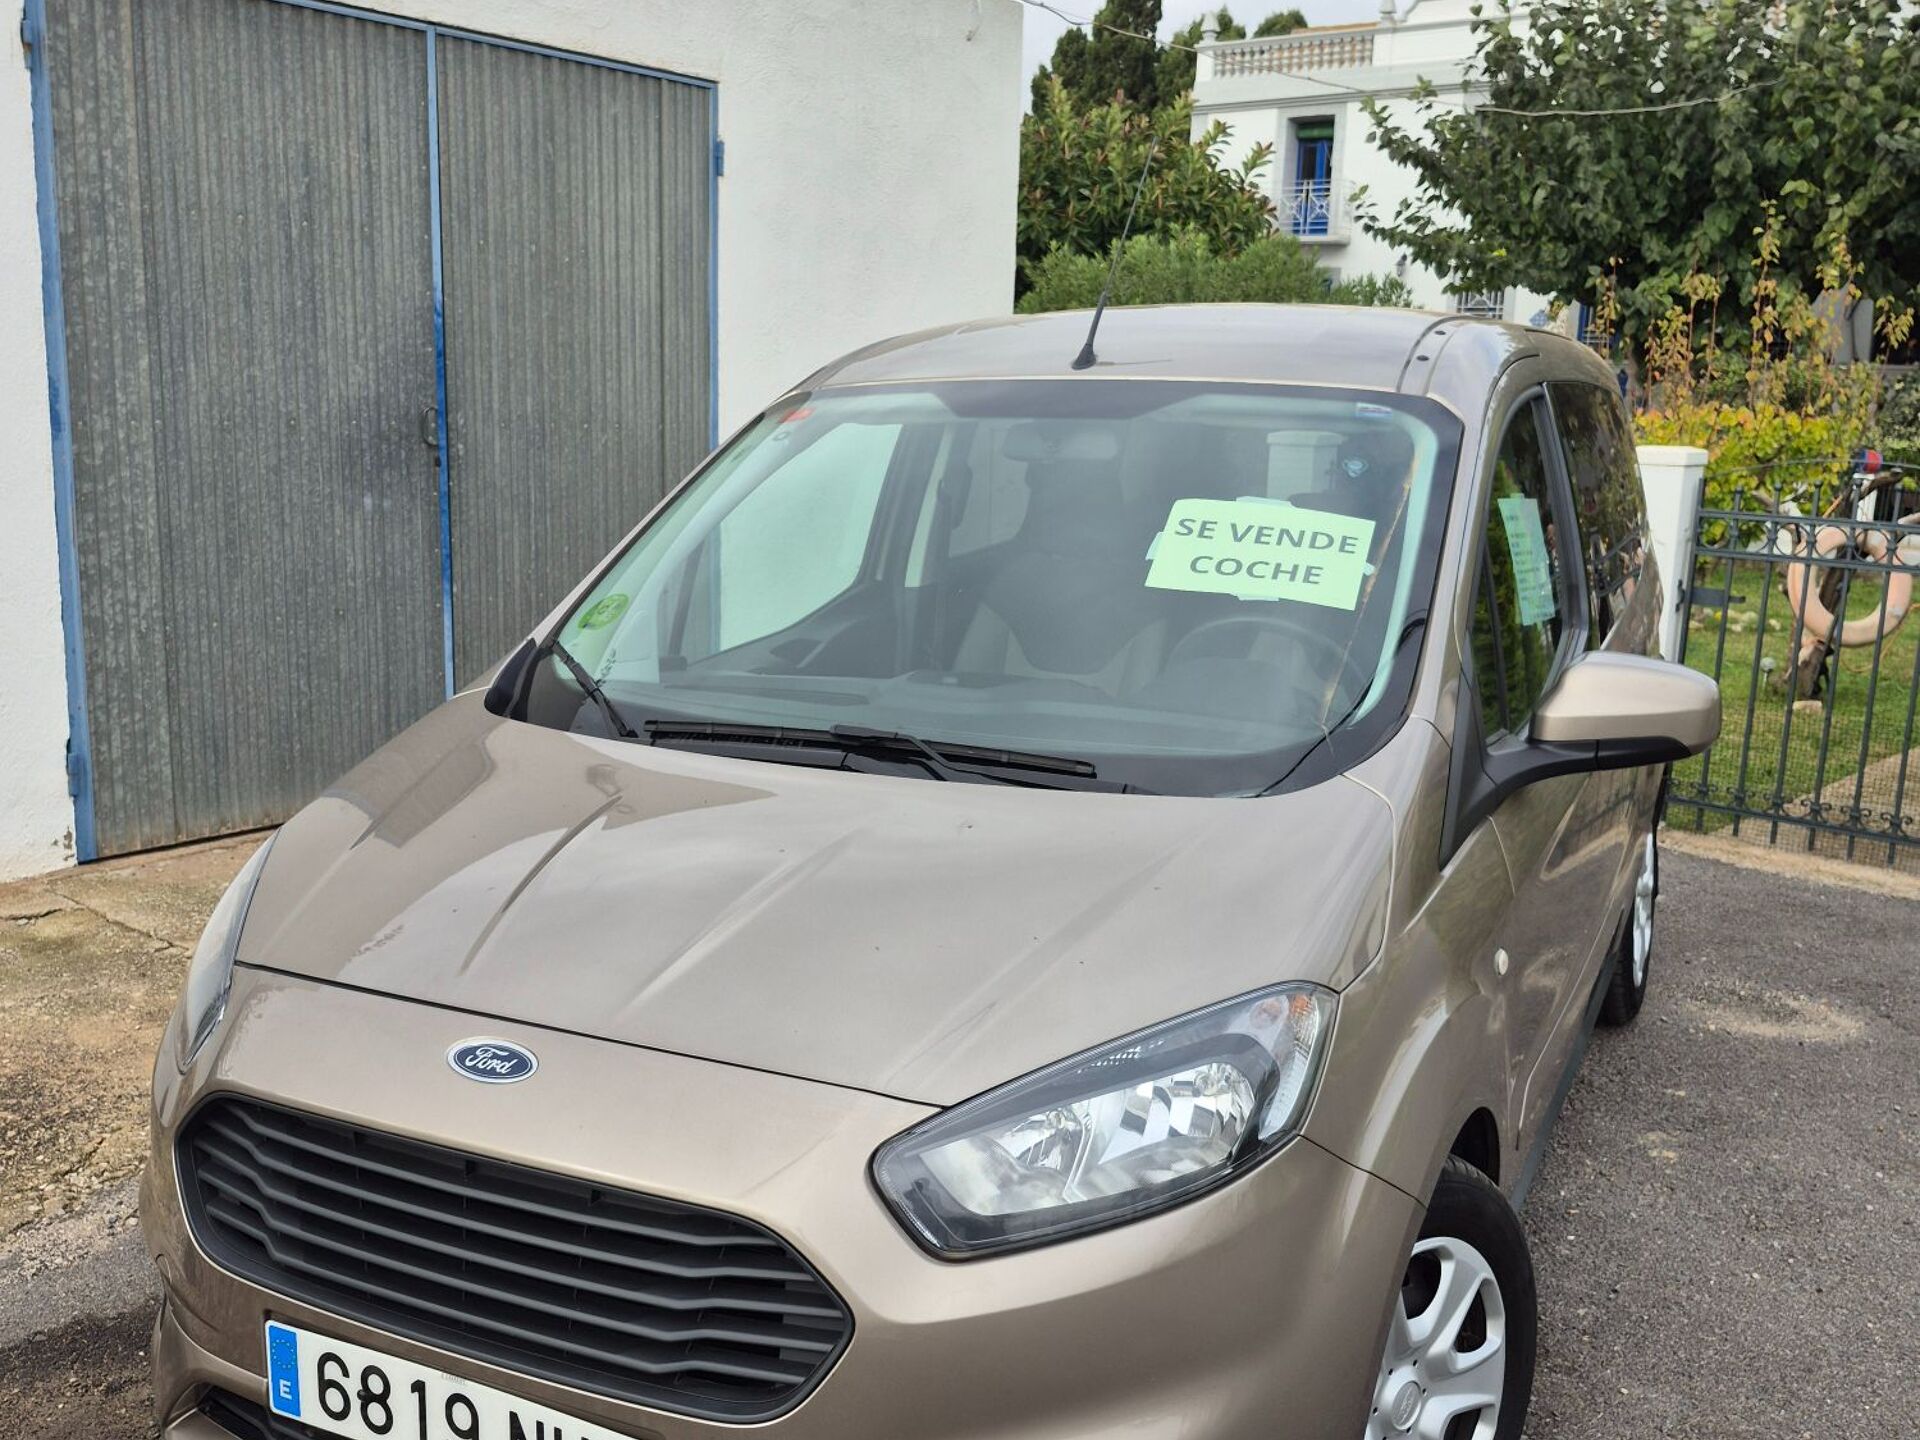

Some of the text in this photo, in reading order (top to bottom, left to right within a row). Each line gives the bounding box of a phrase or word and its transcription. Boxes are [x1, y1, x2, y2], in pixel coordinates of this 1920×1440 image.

[1174, 518, 1359, 554] SE VENDE
[1190, 555, 1325, 585] COCHE
[465, 1046, 519, 1074] Ford
[279, 1378, 293, 1401] E
[316, 1351, 481, 1440] 6819
